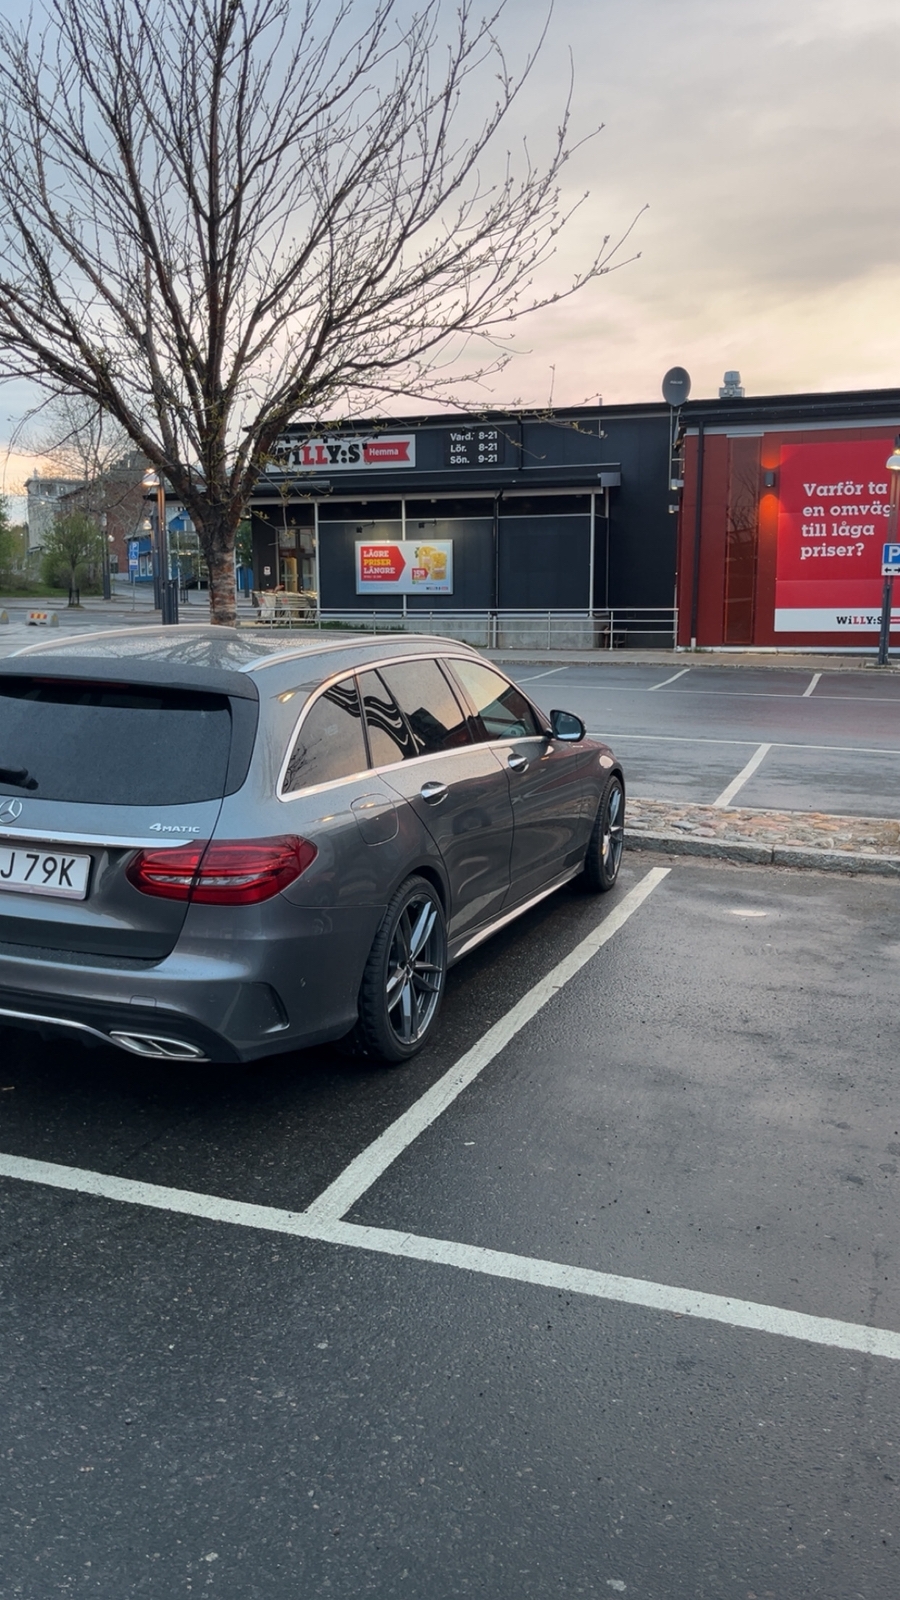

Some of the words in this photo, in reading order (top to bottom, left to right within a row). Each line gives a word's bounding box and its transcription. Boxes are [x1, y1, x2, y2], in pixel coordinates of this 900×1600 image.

[450, 432, 474, 441] Vard.
[478, 431, 498, 440] 8-21
[369, 447, 399, 456] Hemma
[450, 444, 467, 453] Lör.
[478, 443, 498, 451] 8-21
[450, 455, 470, 464] Sön.
[478, 454, 498, 463] 9-21
[803, 481, 864, 497] Varför
[868, 482, 888, 495] ta
[802, 506, 825, 517] en
[802, 523, 827, 537] till
[831, 521, 875, 538] låga
[800, 542, 865, 560] priser?
[888, 546, 900, 562] P
[149, 823, 200, 833] 4MATIC
[24, 853, 76, 887] 79K
